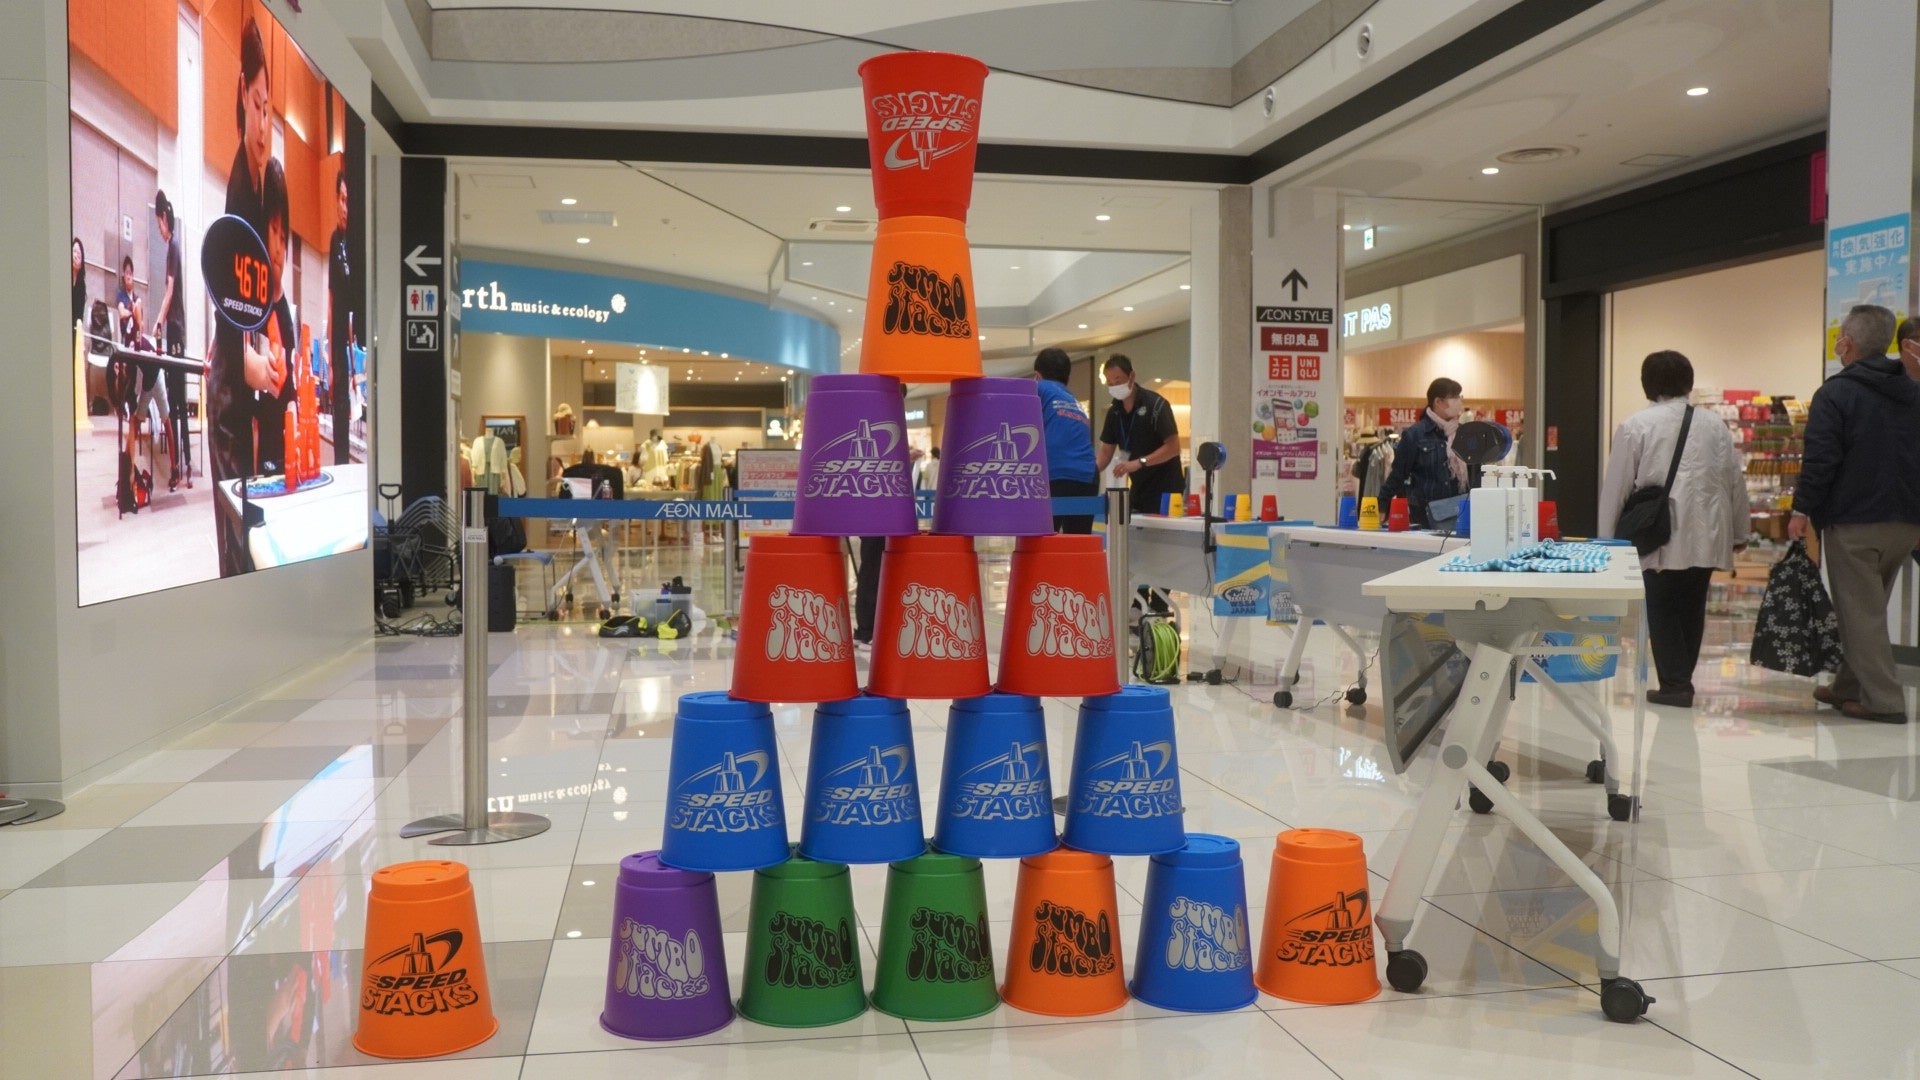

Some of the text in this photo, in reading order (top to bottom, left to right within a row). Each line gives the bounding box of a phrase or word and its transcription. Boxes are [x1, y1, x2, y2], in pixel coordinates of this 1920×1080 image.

[871, 91, 979, 122] STACKS
[882, 116, 965, 131] SPEED
[462, 281, 507, 311] rth
[224, 298, 263, 317] SPEED STACKS
[1295, 310, 1329, 322] STYLE
[1361, 303, 1391, 333] PAS
[1271, 332, 1319, 347] 無印良品
[1390, 409, 1416, 423] SALE
[823, 460, 904, 473] SPEED
[963, 462, 1043, 475] SPEED
[804, 473, 912, 498] STACKS
[944, 475, 1050, 499] STACKS
[706, 503, 752, 518] MALL
[831, 783, 912, 800] SPEED
[1094, 779, 1174, 794] SPEED
[688, 789, 773, 807] SPEED
[951, 793, 1051, 820] STACK
[1078, 793, 1183, 819] STACKS
[671, 802, 781, 832] STACKS
[815, 799, 919, 825] STACKS
[1299, 926, 1371, 943] SPEED
[1277, 939, 1375, 966] STACKS
[377, 968, 466, 990] SPEED
[362, 983, 478, 1016] STACKS
